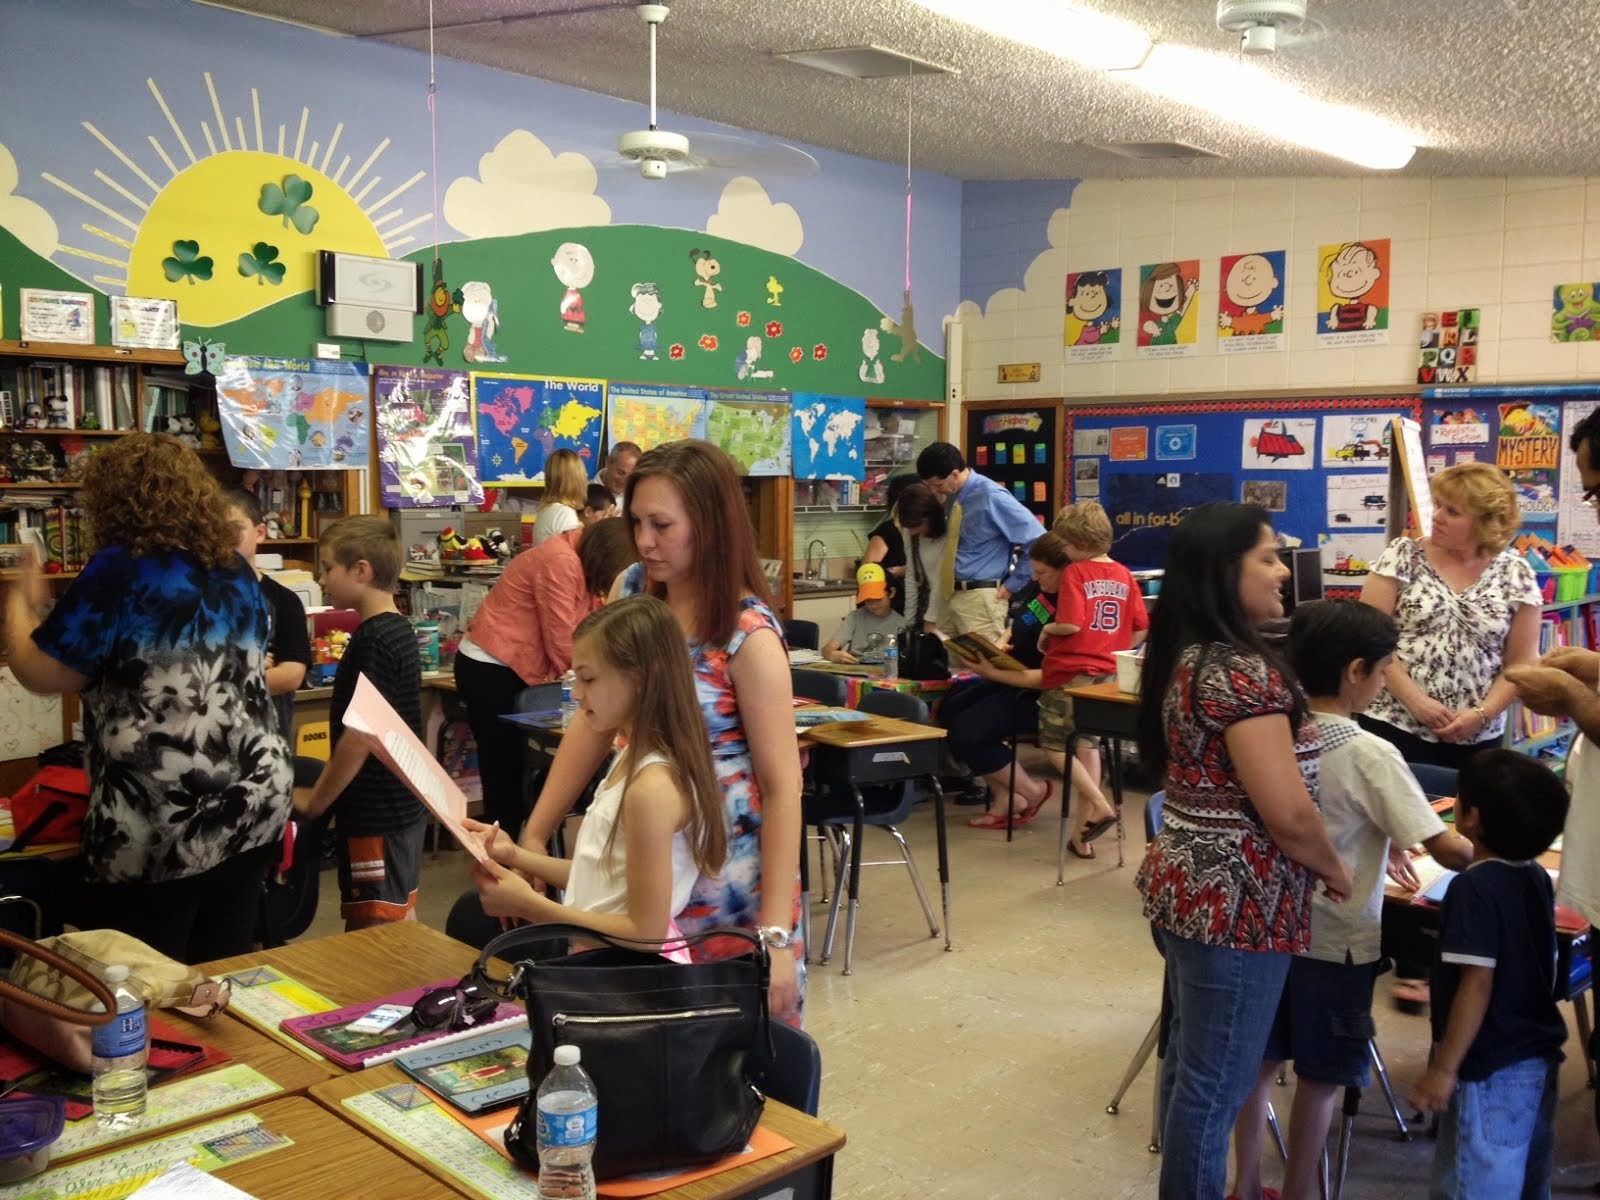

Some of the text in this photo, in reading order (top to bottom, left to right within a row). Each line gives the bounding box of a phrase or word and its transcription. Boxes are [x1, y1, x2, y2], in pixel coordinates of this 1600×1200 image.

[544, 379, 599, 392] The World
[610, 386, 620, 394] The
[621, 387, 639, 395] United
[640, 388, 658, 396] States
[1439, 425, 1479, 437] Realistic
[1451, 432, 1481, 442] Fiction
[1499, 436, 1558, 466] MYSTERY
[1115, 511, 1131, 525] all
[1133, 511, 1145, 525] in
[1089, 599, 1121, 633] 18
[303, 731, 327, 742] BOOKS
